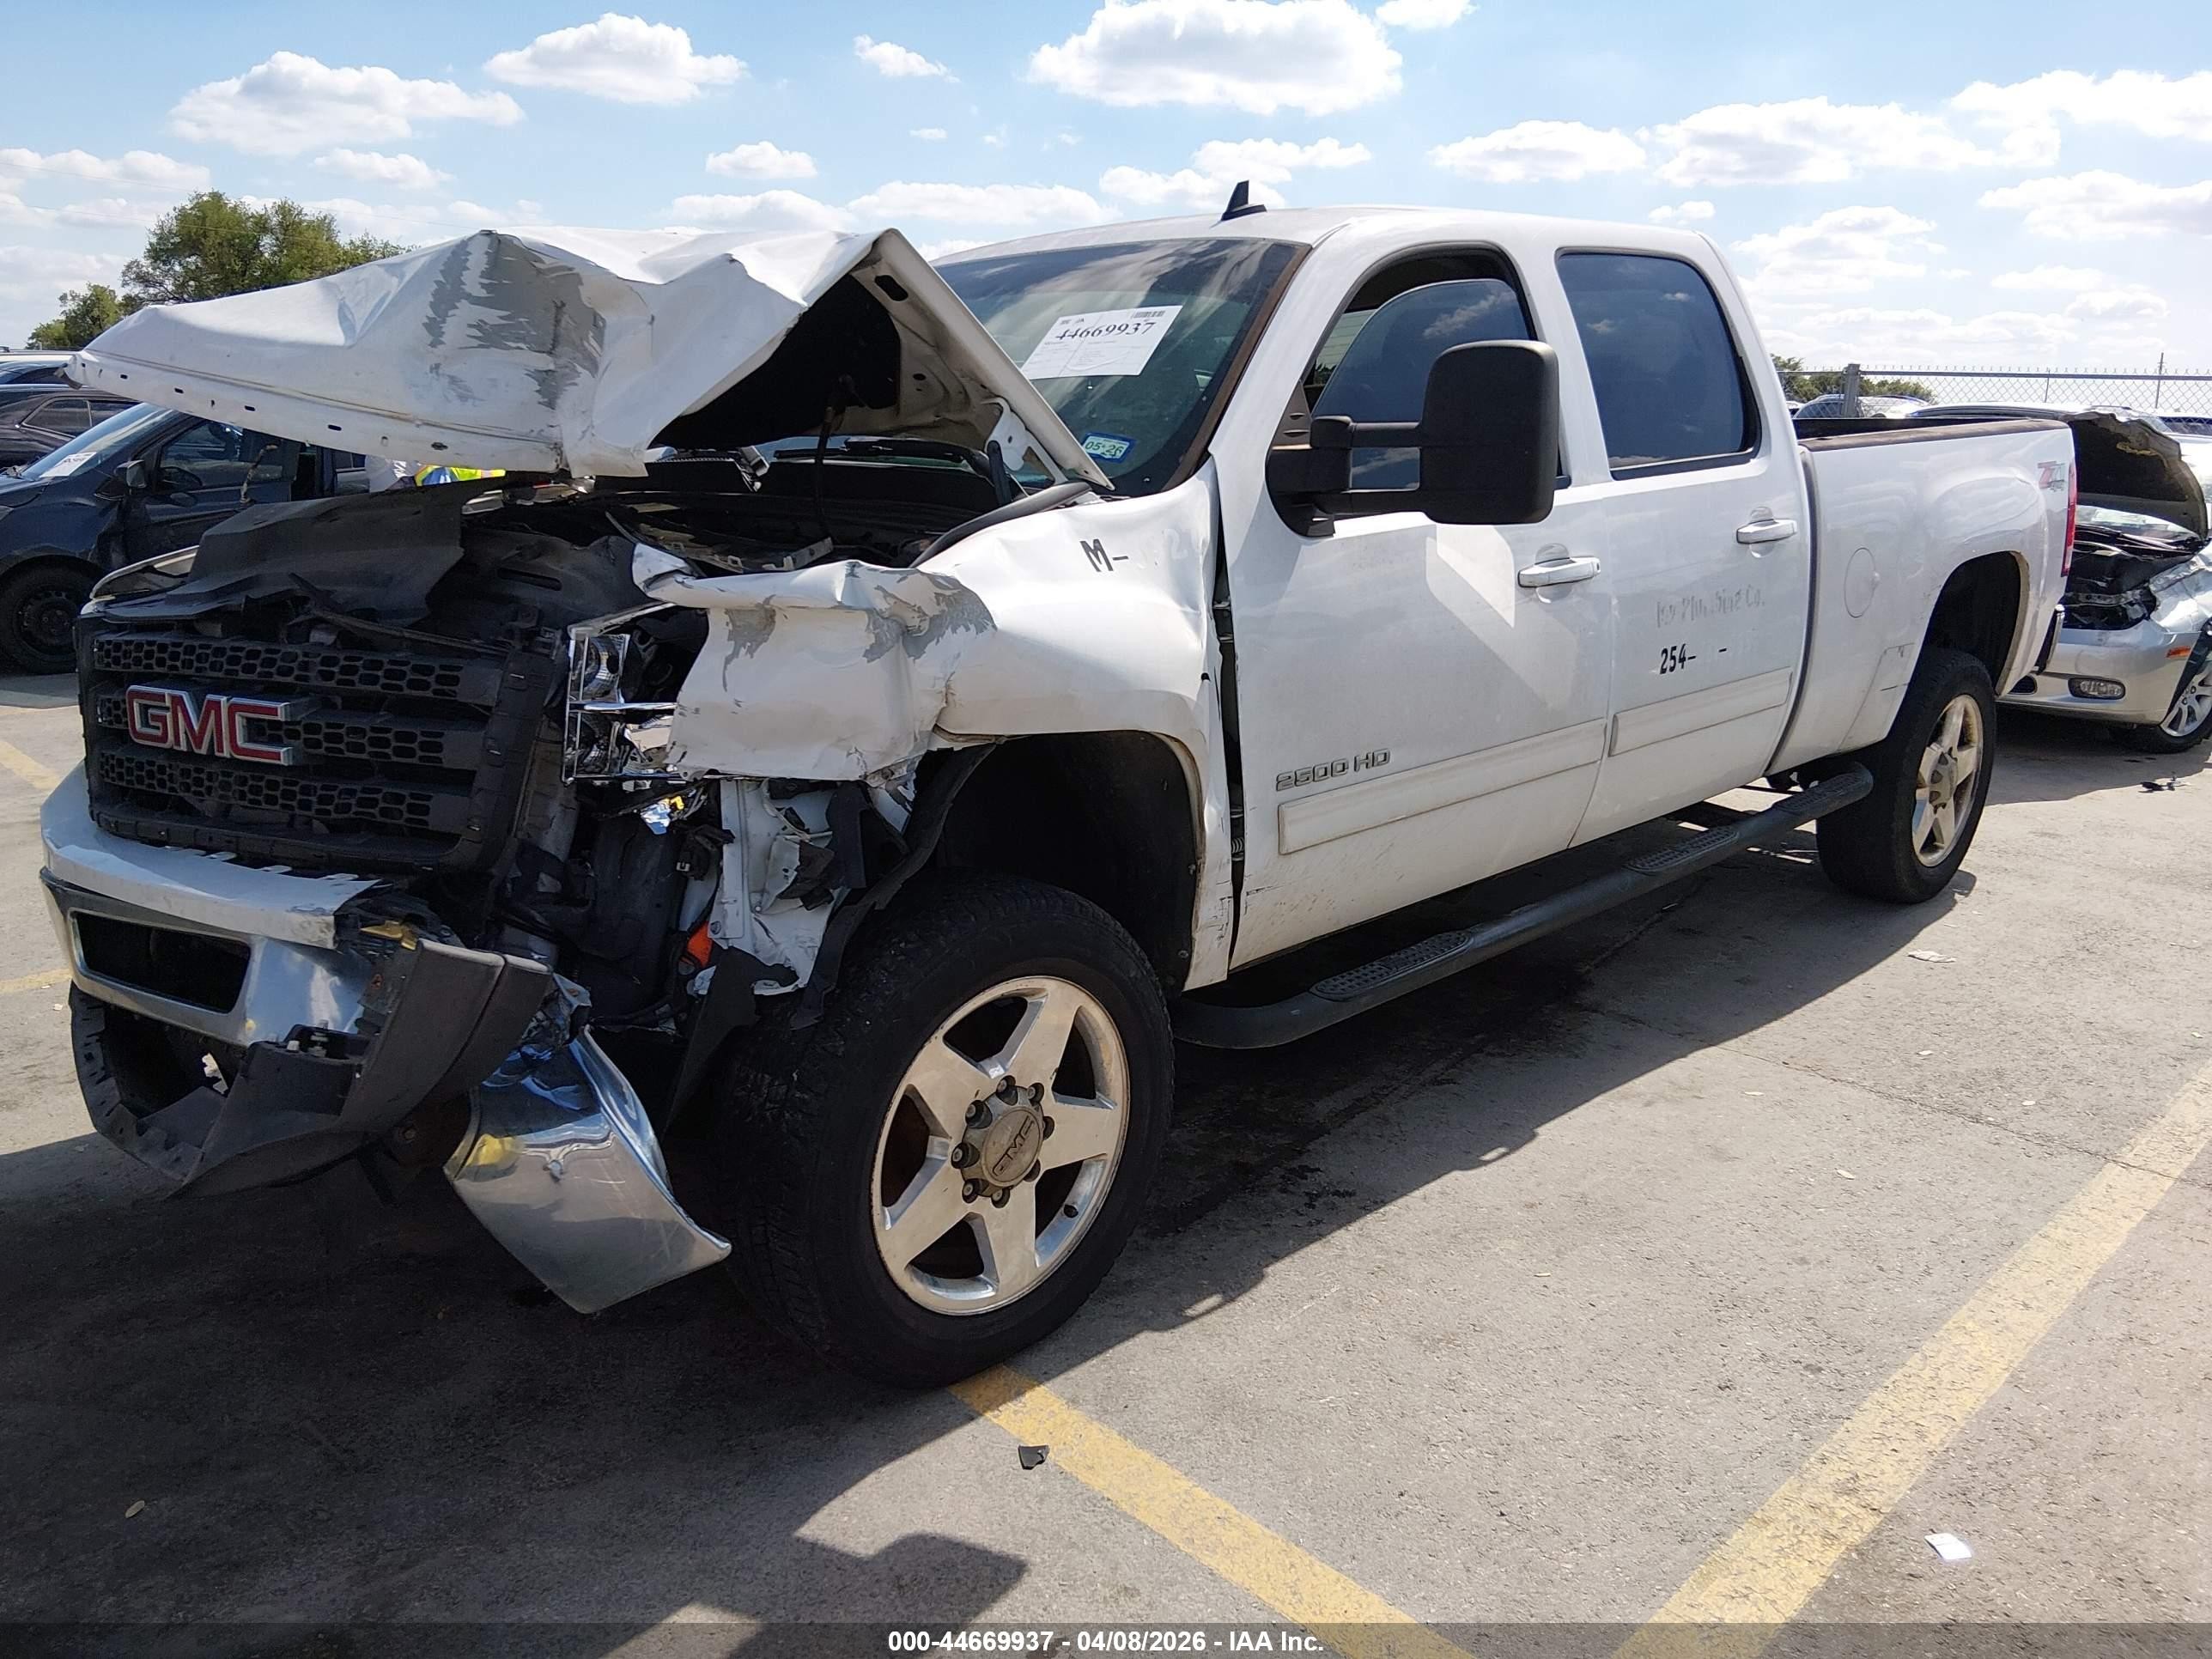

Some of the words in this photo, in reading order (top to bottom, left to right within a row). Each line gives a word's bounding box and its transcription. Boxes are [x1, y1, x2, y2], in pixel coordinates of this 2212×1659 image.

[1055, 322, 1156, 340] 44669937
[126, 684, 293, 766] GMC
[1276, 758, 1349, 792] 2500
[1353, 748, 1391, 773] HD
